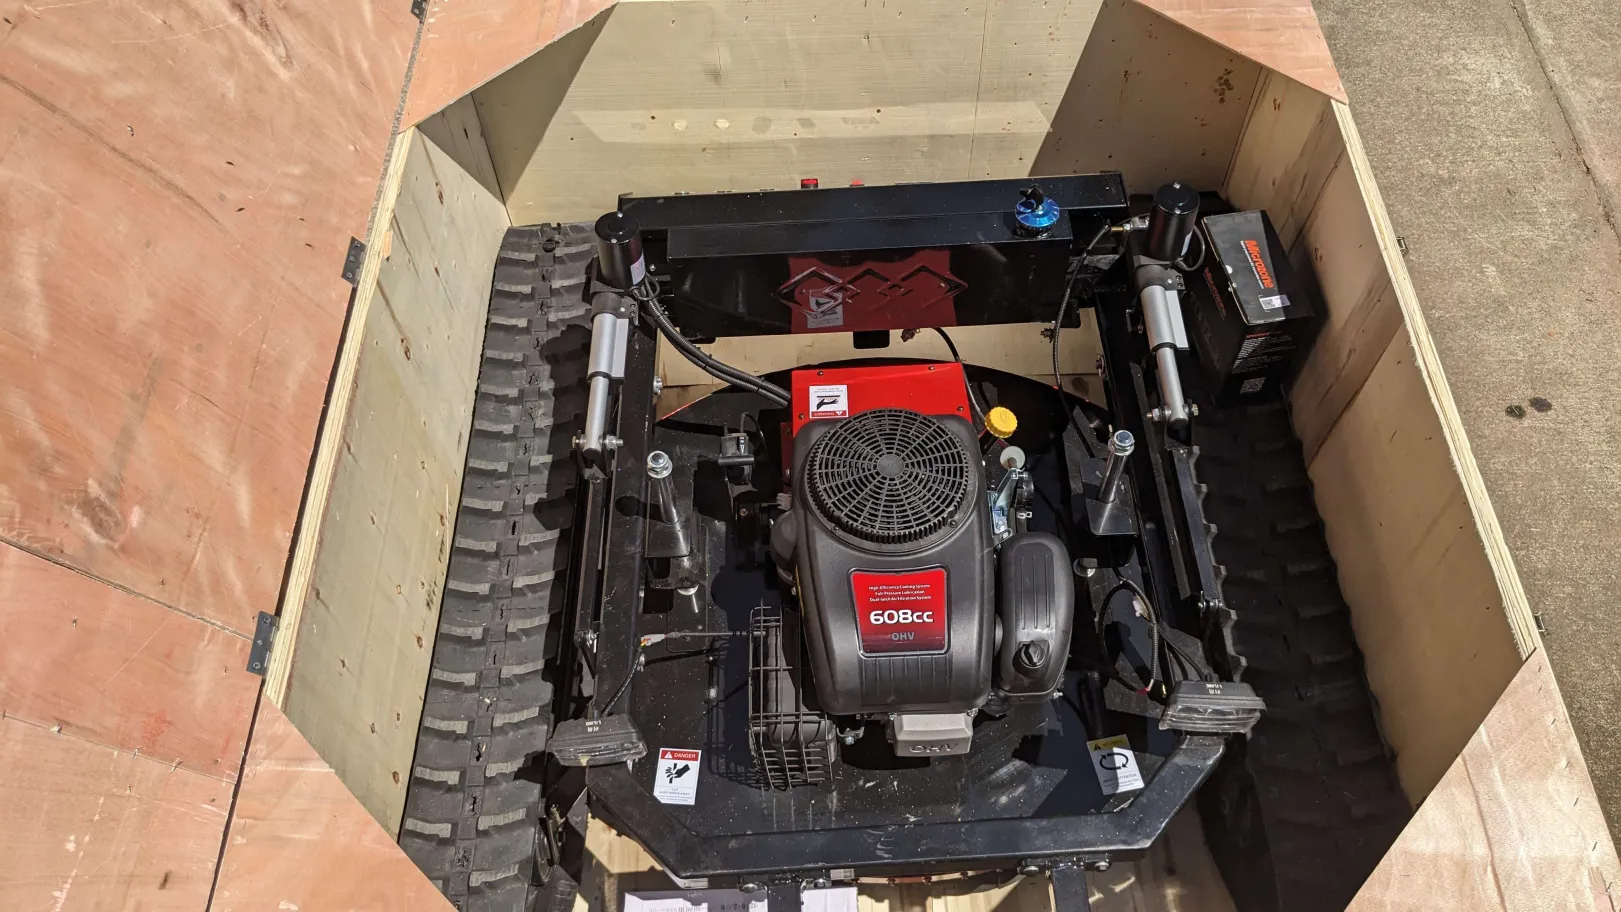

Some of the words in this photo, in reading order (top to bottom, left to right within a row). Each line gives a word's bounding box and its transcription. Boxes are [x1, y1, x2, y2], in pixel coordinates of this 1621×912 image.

[1244, 239, 1274, 289] Microzone
[869, 609, 934, 625] 608cc
[891, 631, 915, 641] OHV
[909, 742, 959, 754] OHV
